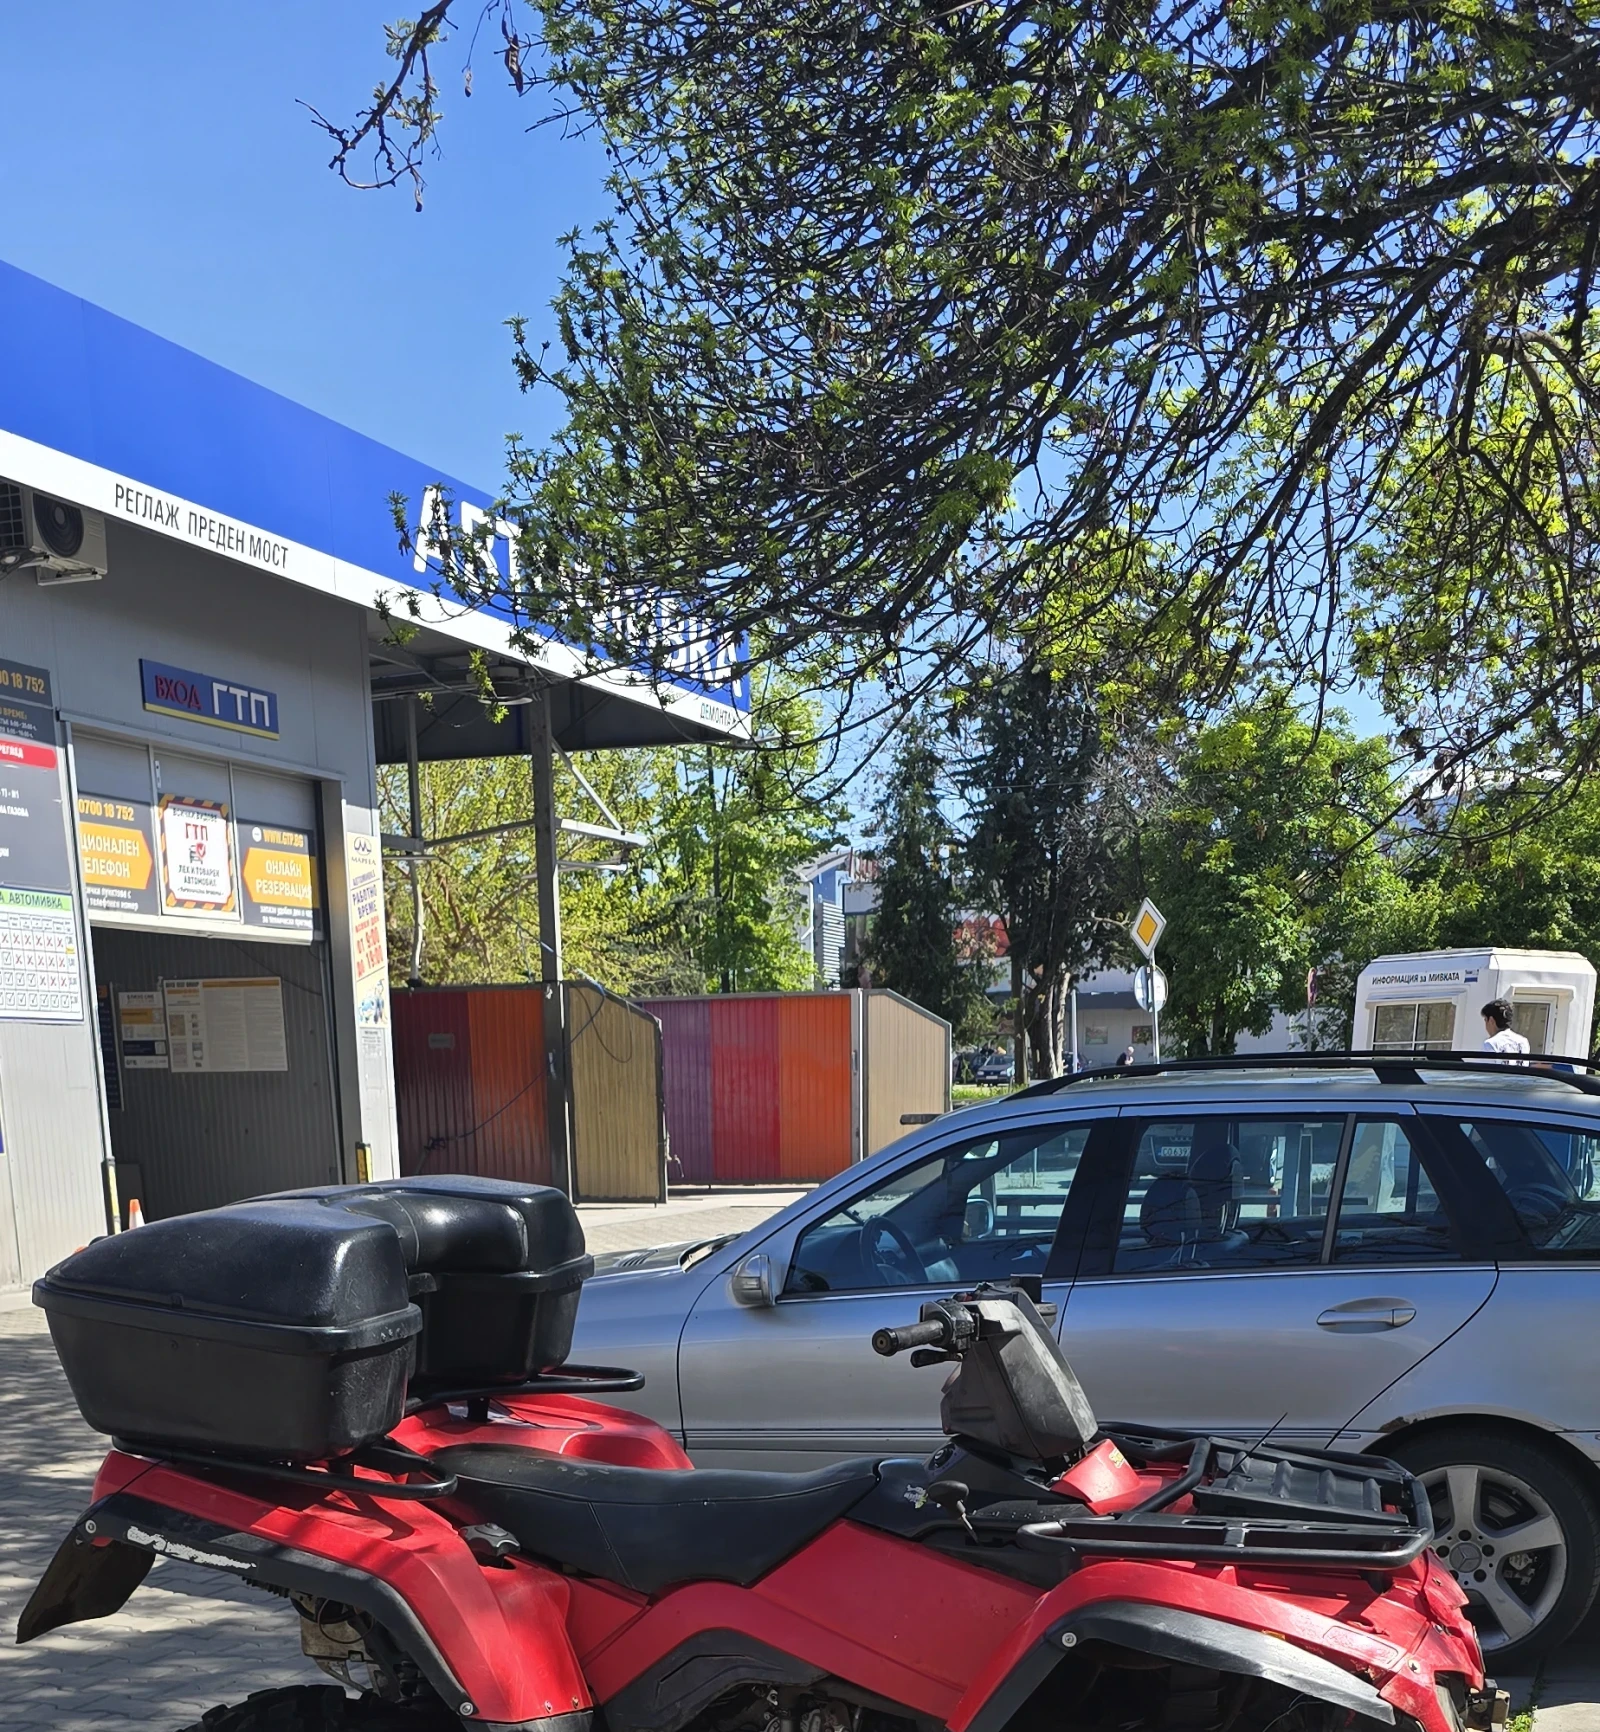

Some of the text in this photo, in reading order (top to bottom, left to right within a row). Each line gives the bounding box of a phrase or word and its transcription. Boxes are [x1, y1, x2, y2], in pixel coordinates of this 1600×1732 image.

[115, 483, 289, 569] РЕГЛАЖ ПРЕДЕН МОСТ
[11, 673, 23, 689] 18
[25, 675, 46, 695] 752
[155, 675, 270, 727] ВХОД ГТП
[79, 798, 135, 821] 0700 18 752
[185, 822, 209, 841] ГТП
[83, 856, 131, 878] ЕЛЕФОН
[265, 859, 302, 878] ОНЛАЙН
[9, 892, 63, 909] АВТОМИВКА
[352, 884, 377, 905] РАБОТНО
[358, 900, 377, 919] ВРЕМЕ
[357, 926, 380, 954] ОТ 9:00
[366, 944, 383, 969] 19:00
[1372, 974, 1419, 985] ИНФОРМАЦИЯ
[1428, 972, 1460, 982] МИВКАТА
